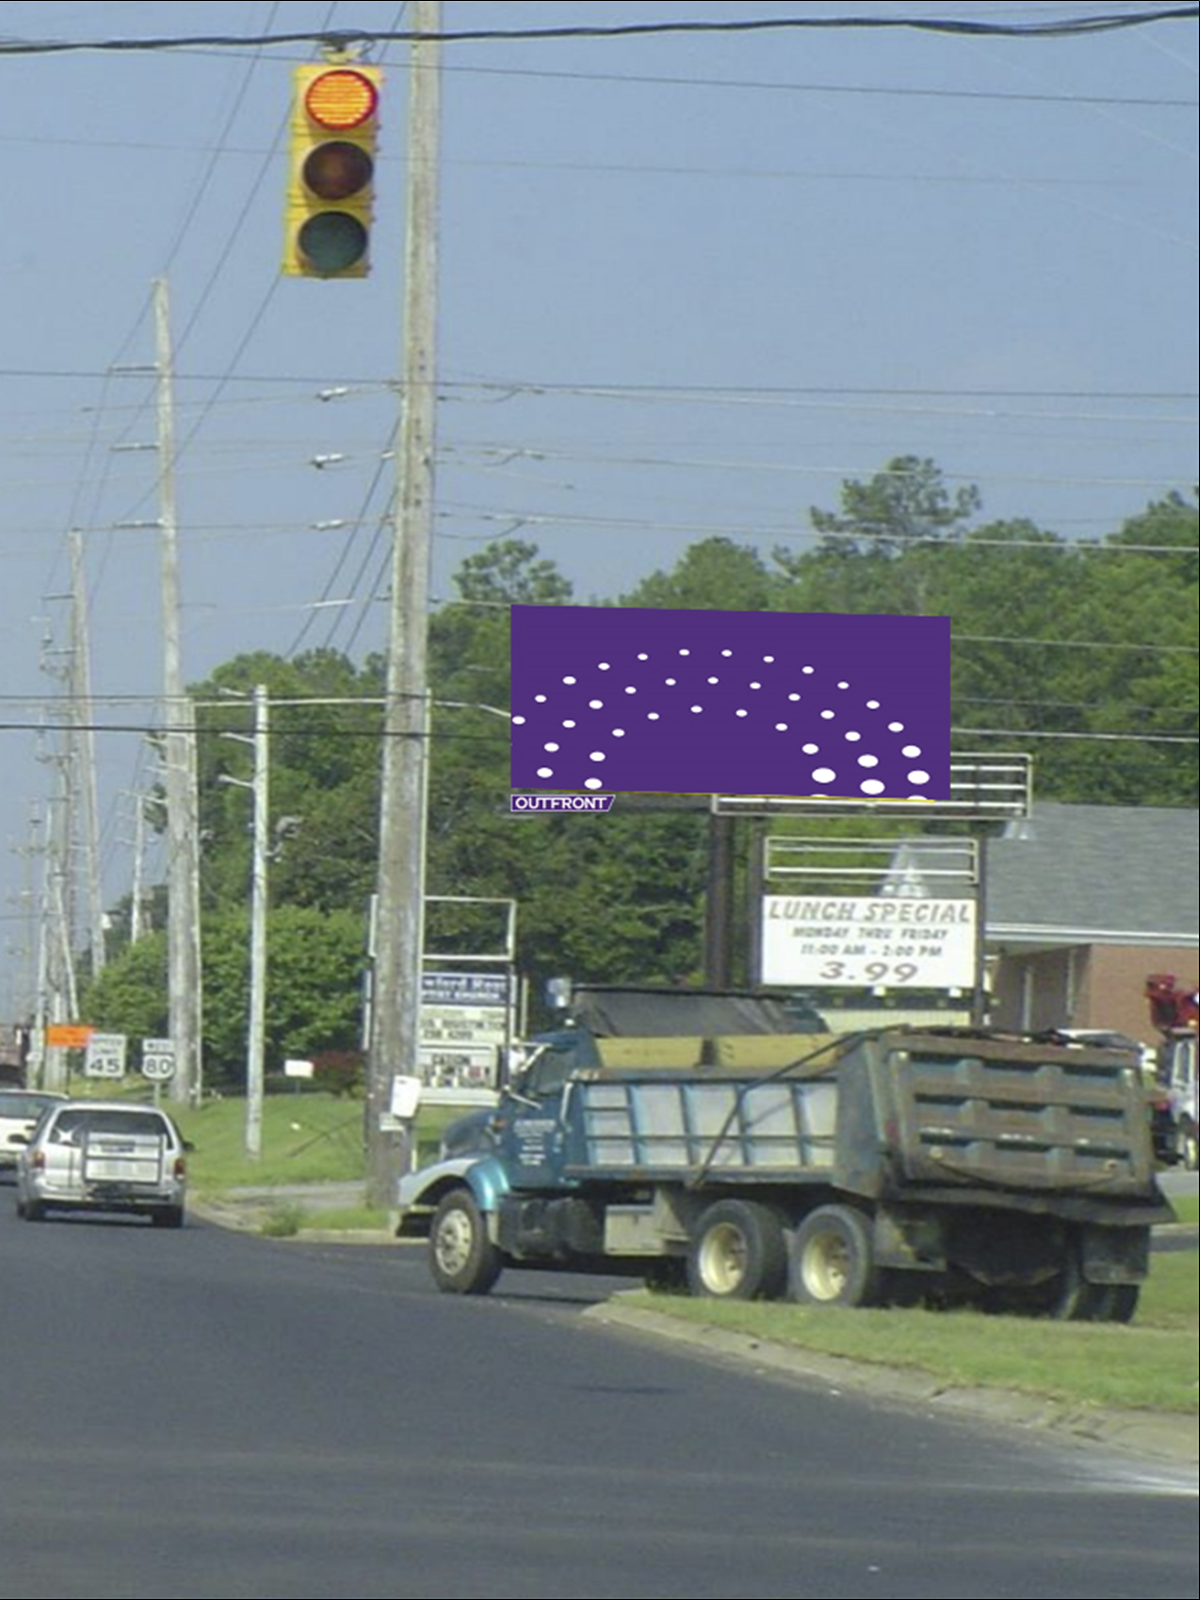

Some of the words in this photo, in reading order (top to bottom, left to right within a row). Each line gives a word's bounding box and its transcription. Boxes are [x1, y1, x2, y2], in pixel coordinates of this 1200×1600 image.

[515, 796, 607, 809] OUTFRONT
[768, 900, 855, 921] LUNCH
[863, 903, 970, 923] SPECIAL
[792, 927, 849, 938] MONDAY
[858, 928, 893, 939] THRU
[901, 929, 948, 940] FRIDAY
[801, 944, 838, 955] 11:00
[842, 944, 866, 955] AM
[882, 946, 914, 957] 2:00
[918, 947, 942, 957] PM
[819, 961, 918, 982] 3.99
[90, 1058, 120, 1073] 45
[146, 1058, 170, 1075] 80
